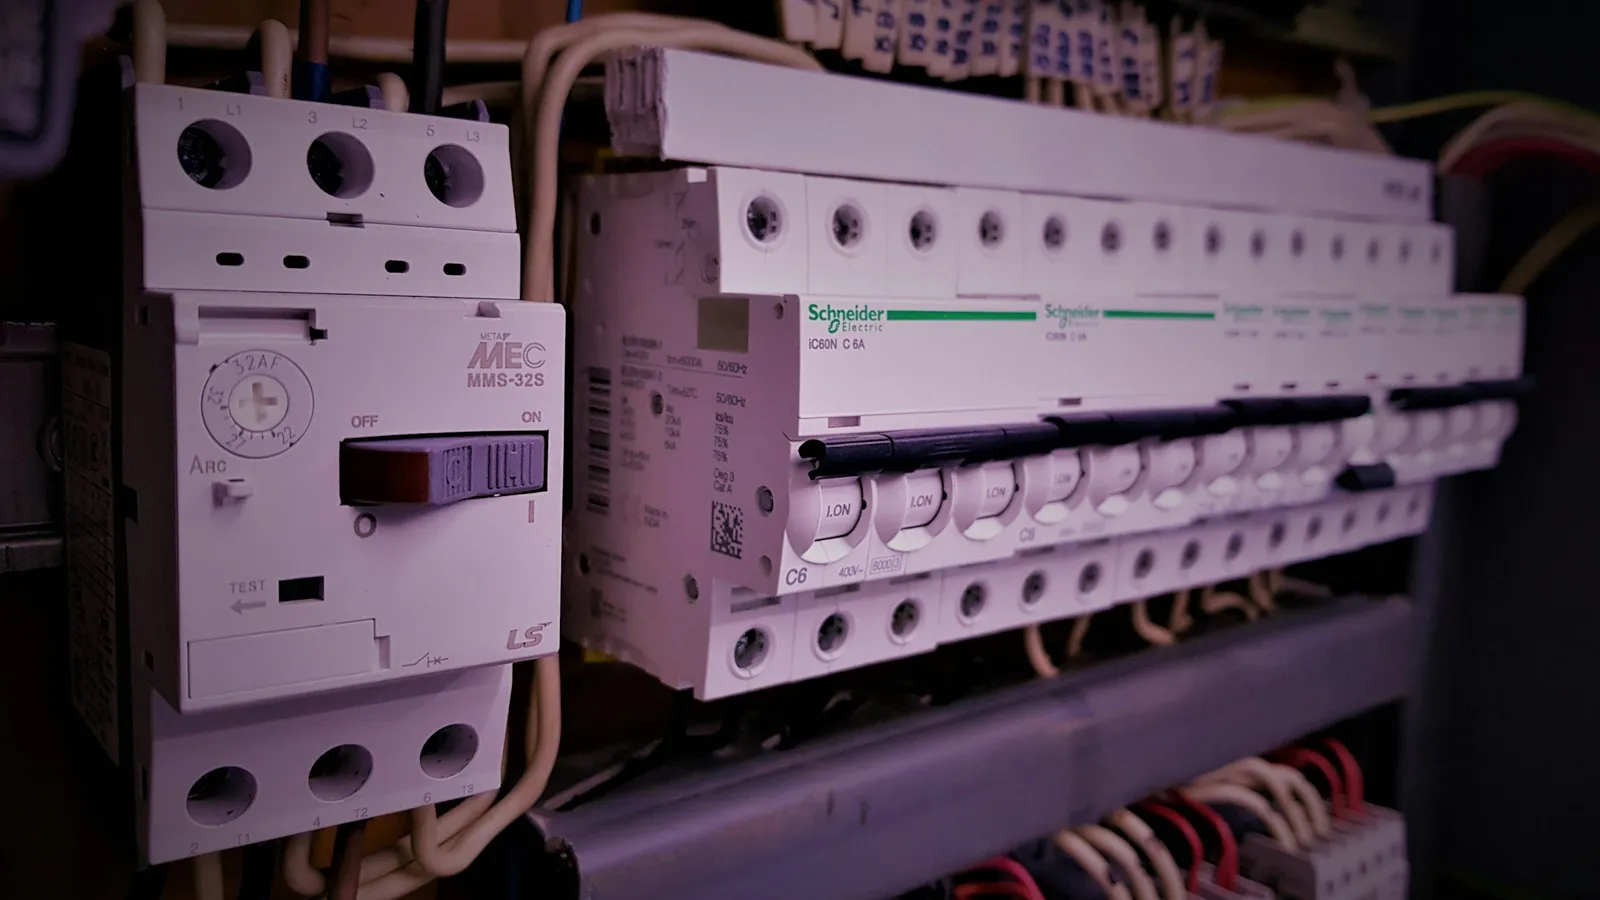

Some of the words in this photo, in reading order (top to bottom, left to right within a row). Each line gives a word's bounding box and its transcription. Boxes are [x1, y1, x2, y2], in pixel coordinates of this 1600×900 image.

[226, 103, 242, 116] L1
[308, 112, 318, 124] 3
[352, 117, 368, 130] L2
[426, 125, 435, 137] 5
[466, 130, 480, 142] L3
[808, 304, 884, 321] Schneider
[842, 322, 883, 332] Electric
[481, 333, 503, 341] META
[808, 338, 838, 350] iC60N
[843, 339, 850, 350] C
[853, 339, 865, 350] 6A
[467, 342, 546, 369] MEC
[232, 354, 282, 375] 32AF
[717, 360, 748, 375] 50/60Hz
[467, 373, 545, 388] MMS-32S
[351, 415, 378, 429] OFF
[521, 411, 542, 423] ON
[277, 426, 296, 445] 22
[910, 495, 933, 508] I.ON
[826, 504, 851, 517] I.ON
[786, 567, 808, 585] C6
[229, 580, 265, 594] TEST
[506, 624, 547, 650] LS
[461, 783, 475, 795] T3
[423, 791, 431, 803] 6
[354, 807, 368, 819] T2
[312, 816, 321, 828] 4
[236, 832, 251, 844] T1
[190, 842, 199, 855] 2
